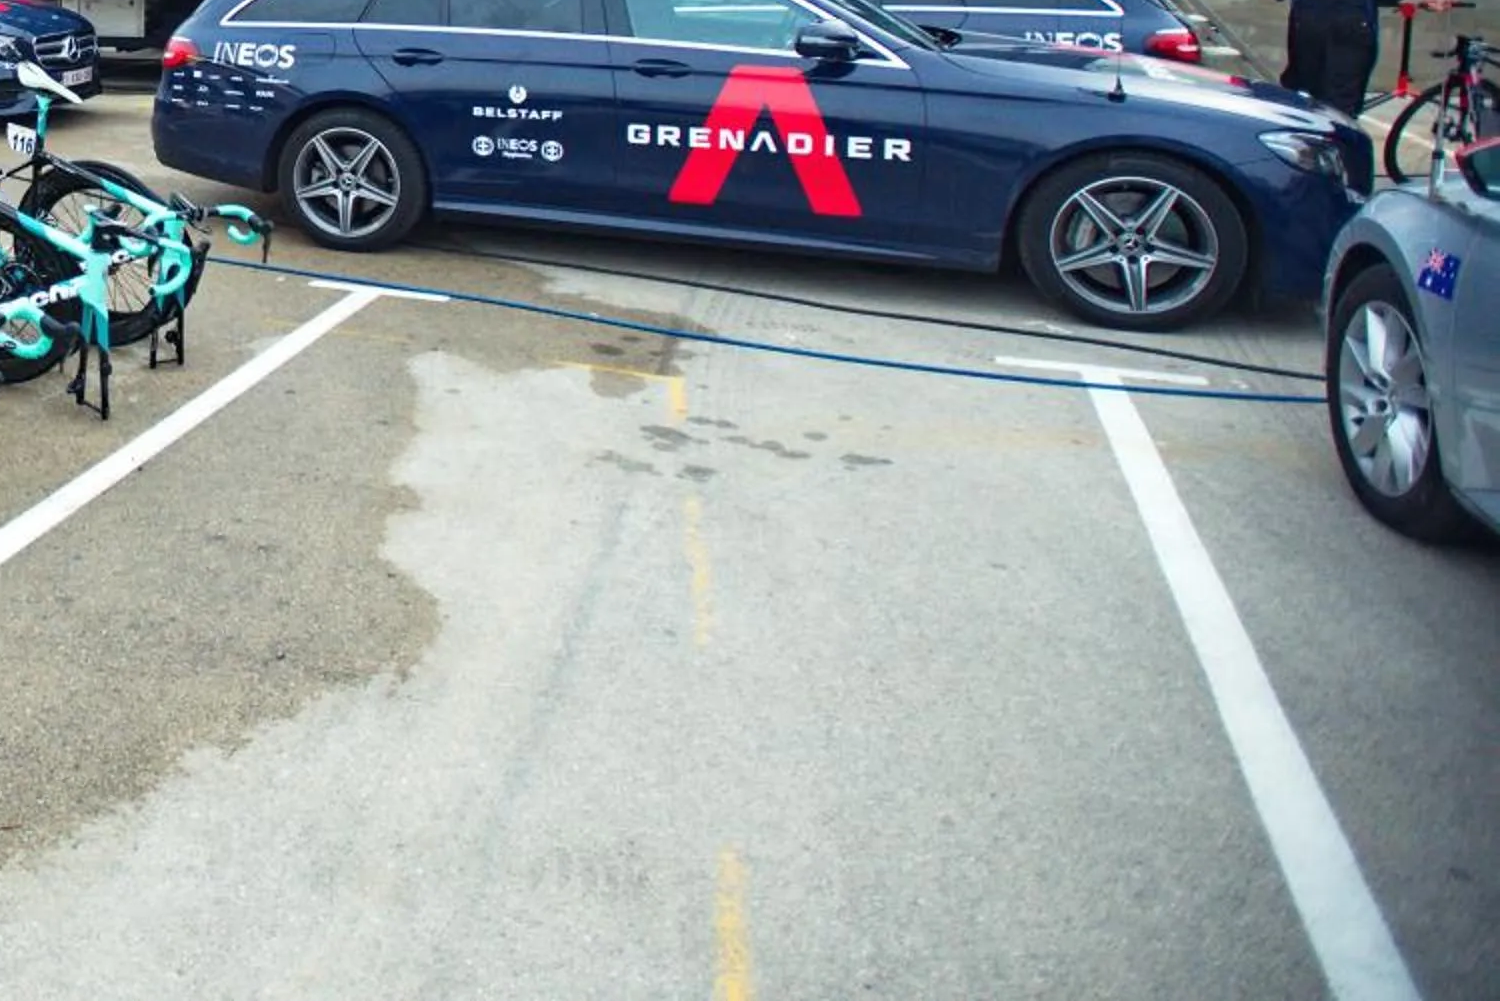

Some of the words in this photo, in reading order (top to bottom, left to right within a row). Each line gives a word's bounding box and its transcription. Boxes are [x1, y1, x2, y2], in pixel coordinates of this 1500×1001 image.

[212, 41, 297, 70] INEOS
[472, 106, 563, 121] BELSTAFF
[13, 134, 34, 155] 116
[497, 137, 538, 152] INEOS
[627, 123, 912, 161] GRENADIER
